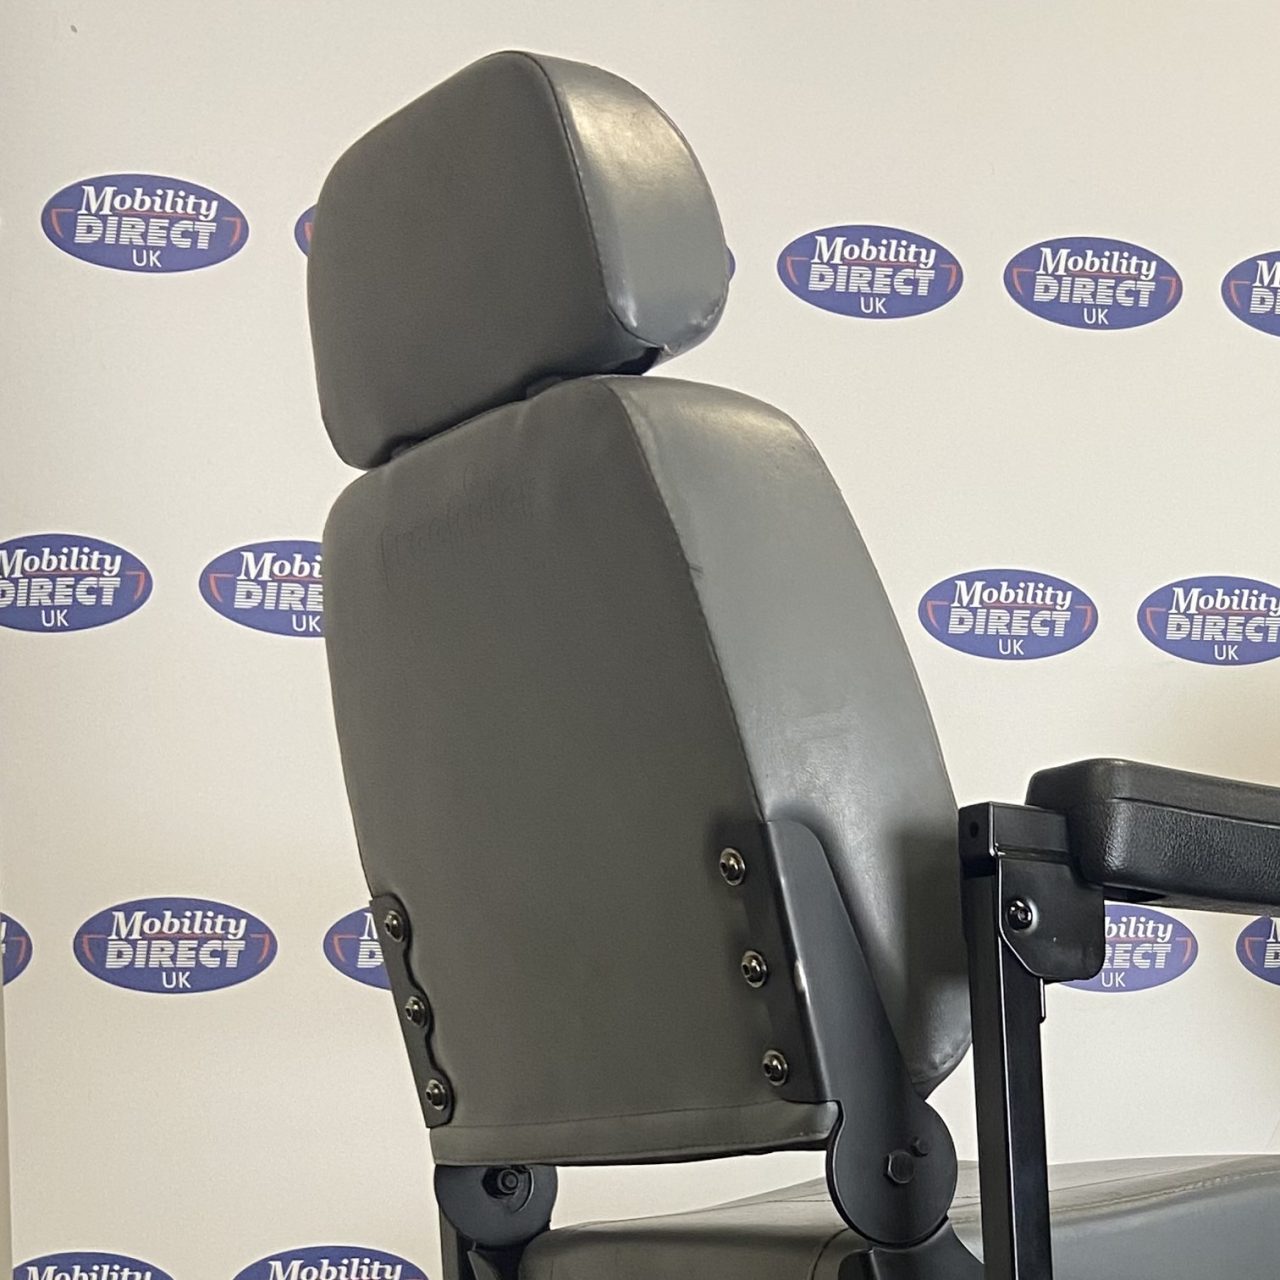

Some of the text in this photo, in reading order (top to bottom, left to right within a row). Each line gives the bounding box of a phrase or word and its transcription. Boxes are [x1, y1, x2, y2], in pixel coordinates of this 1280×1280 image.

[77, 185, 219, 220] Mobility
[74, 215, 217, 249] DIRECT
[132, 249, 162, 268] UK
[812, 236, 936, 267] Mobility
[1039, 247, 1157, 280] Mobility
[808, 264, 935, 296] DIRECT
[1034, 275, 1155, 307] DIRECT
[860, 296, 887, 314] UK
[1083, 308, 1109, 325] UK
[236, 551, 323, 581] Mobi
[233, 580, 324, 612] DIRE
[951, 580, 1073, 609] Mobility
[41, 609, 69, 627] UK
[291, 614, 322, 632] UK
[948, 607, 1071, 637] DIRECT
[998, 639, 1025, 656] UK
[1214, 644, 1238, 661] UK
[110, 911, 248, 941] Mobility
[1104, 916, 1173, 943] bility
[105, 940, 246, 969] DIRECT
[1102, 943, 1172, 969] RECT
[162, 971, 191, 989] UK
[1101, 972, 1126, 987] UK
